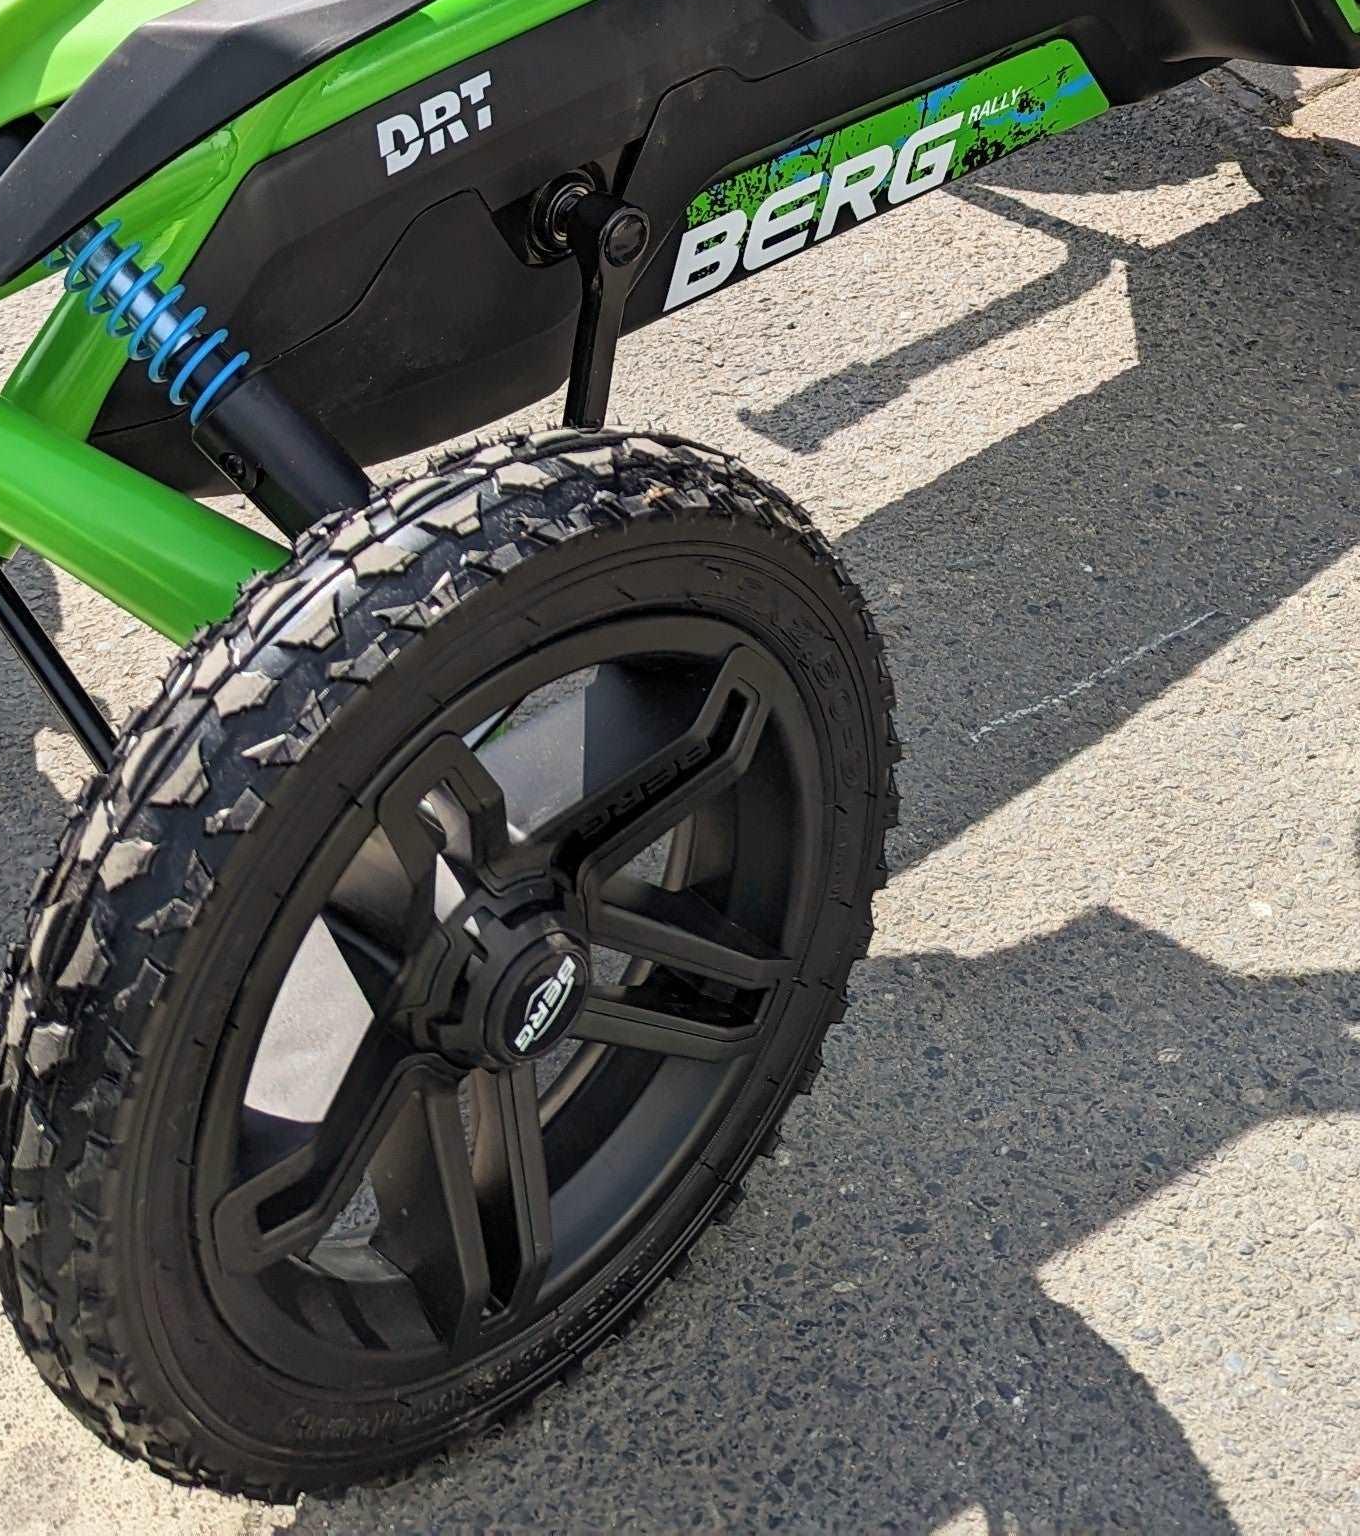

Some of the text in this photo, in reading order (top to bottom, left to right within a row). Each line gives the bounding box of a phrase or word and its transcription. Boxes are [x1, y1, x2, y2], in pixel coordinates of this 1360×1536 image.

[376, 70, 492, 177] DRT
[662, 86, 1024, 312] BERG RALLY
[514, 955, 577, 1052] BERG
